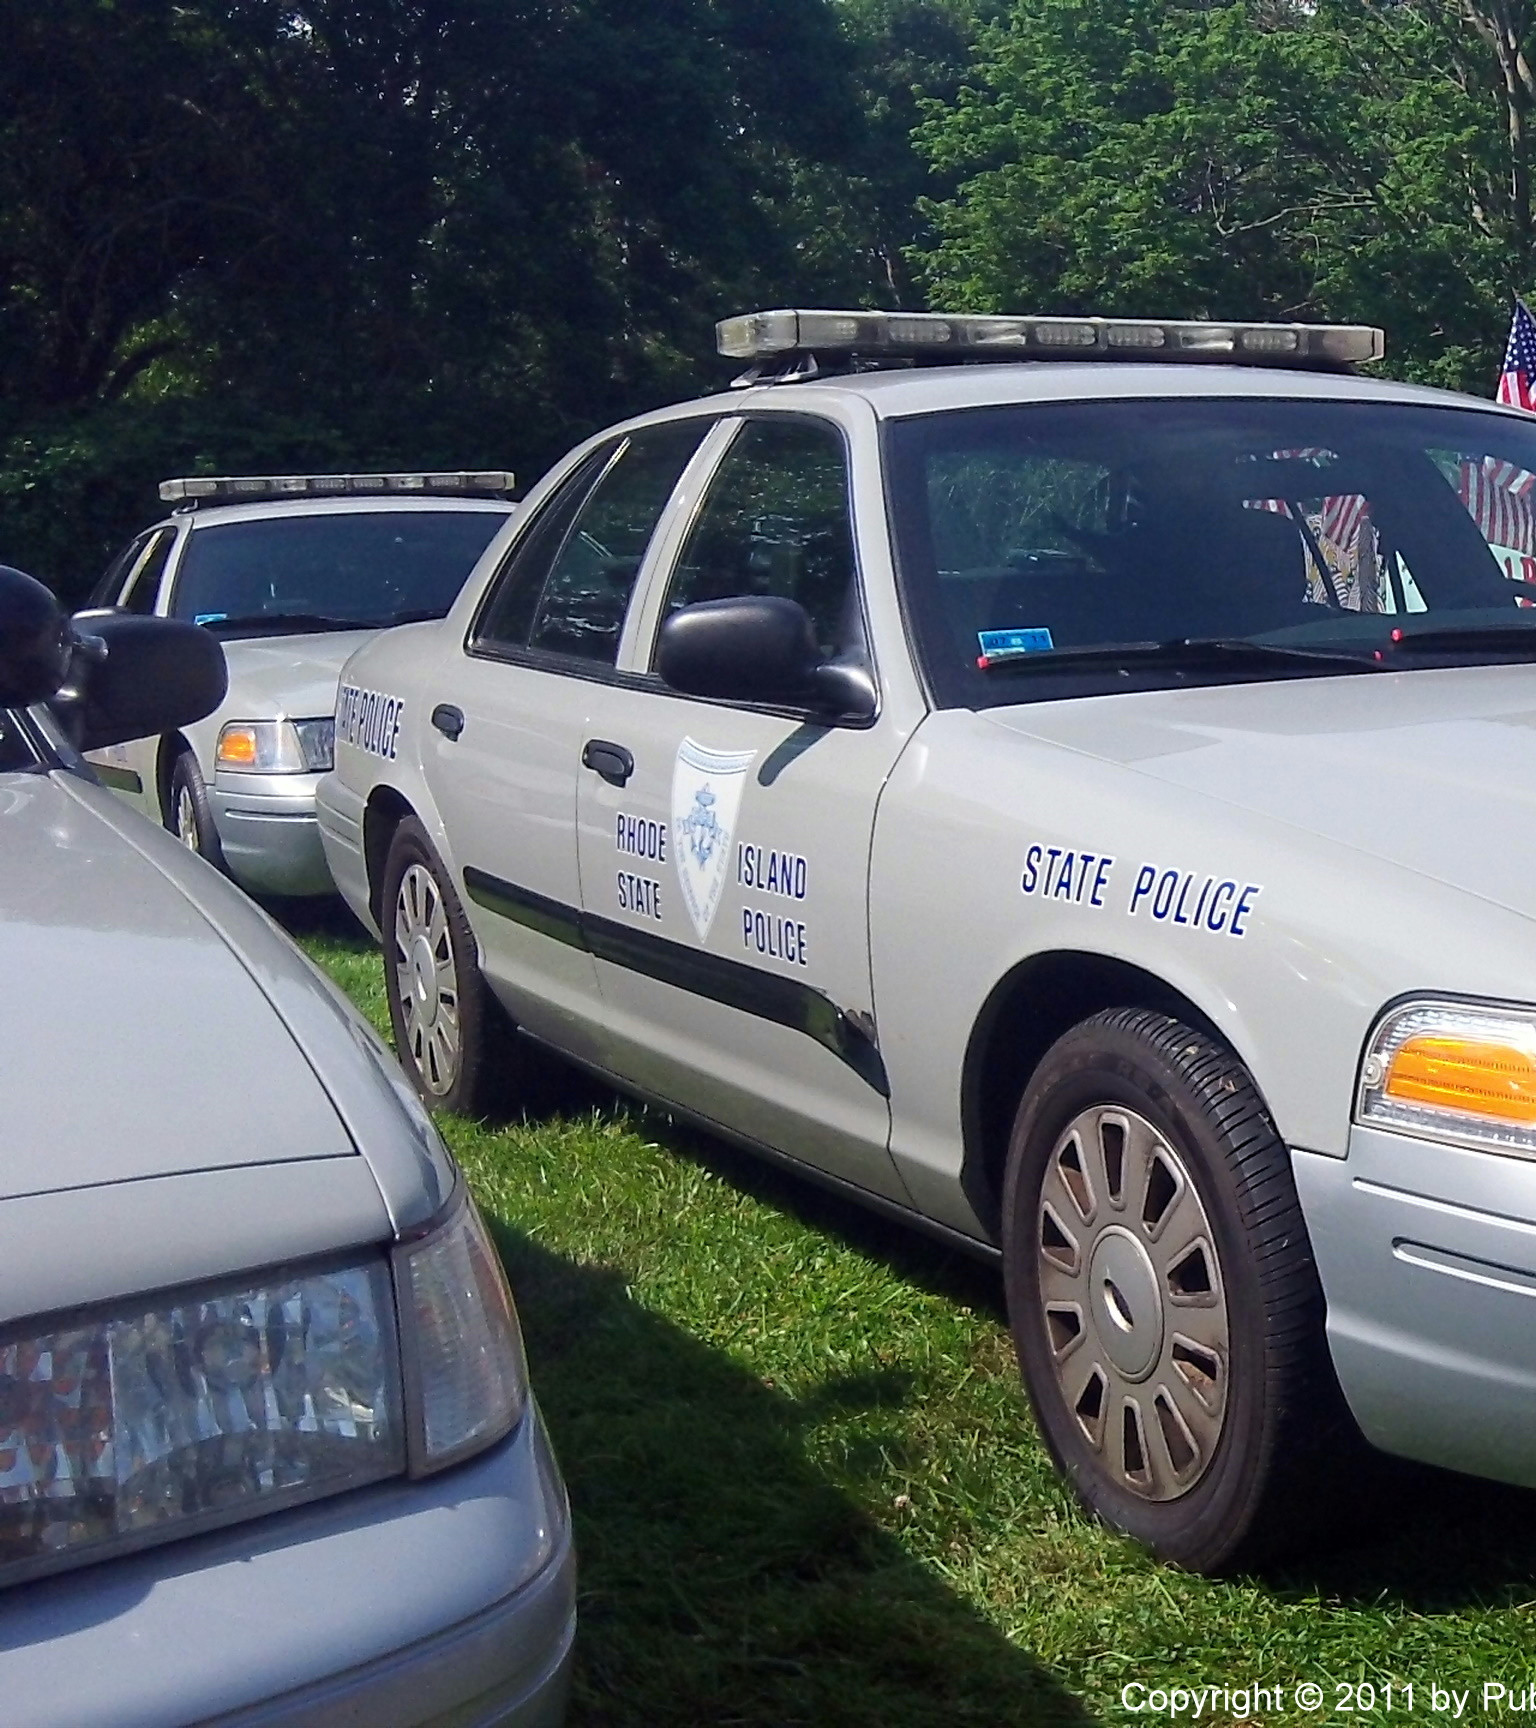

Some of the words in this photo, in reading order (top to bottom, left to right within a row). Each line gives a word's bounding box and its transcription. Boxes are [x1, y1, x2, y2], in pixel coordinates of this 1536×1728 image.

[357, 691, 404, 759] POLICE
[617, 814, 666, 862] RHODE
[738, 843, 807, 899] ISLAND
[1022, 845, 1113, 906] STATE
[1129, 865, 1260, 936] POLICE
[617, 871, 662, 919] STATE
[743, 908, 806, 965] POLICE
